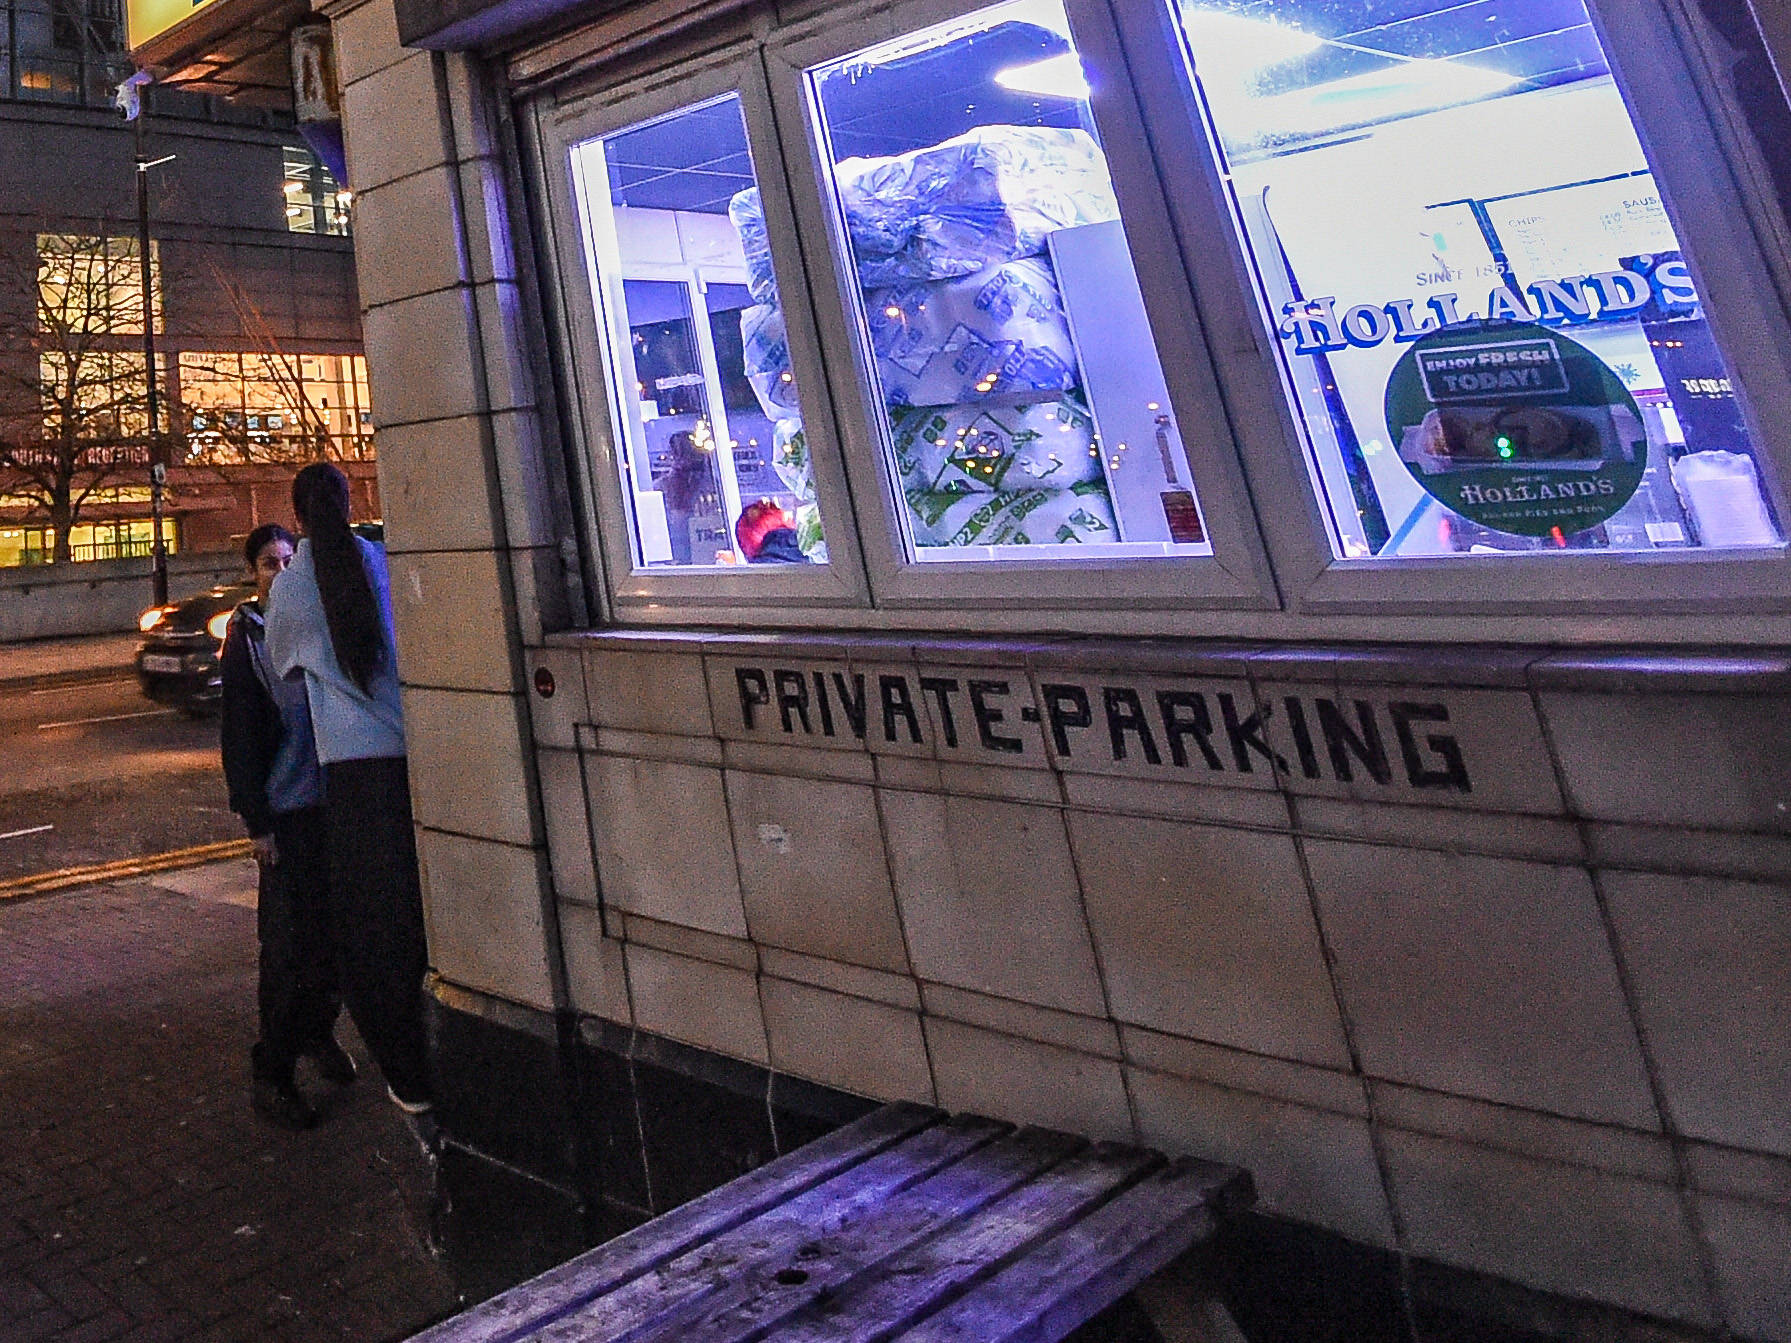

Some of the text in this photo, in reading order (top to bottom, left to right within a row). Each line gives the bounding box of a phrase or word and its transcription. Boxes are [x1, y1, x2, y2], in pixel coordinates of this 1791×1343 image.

[1622, 196, 1661, 209] SAUS
[1425, 349, 1550, 372] ENJOY FRESH
[1442, 367, 1542, 392] TODAY!
[1459, 475, 1615, 505] HOLLAND'S
